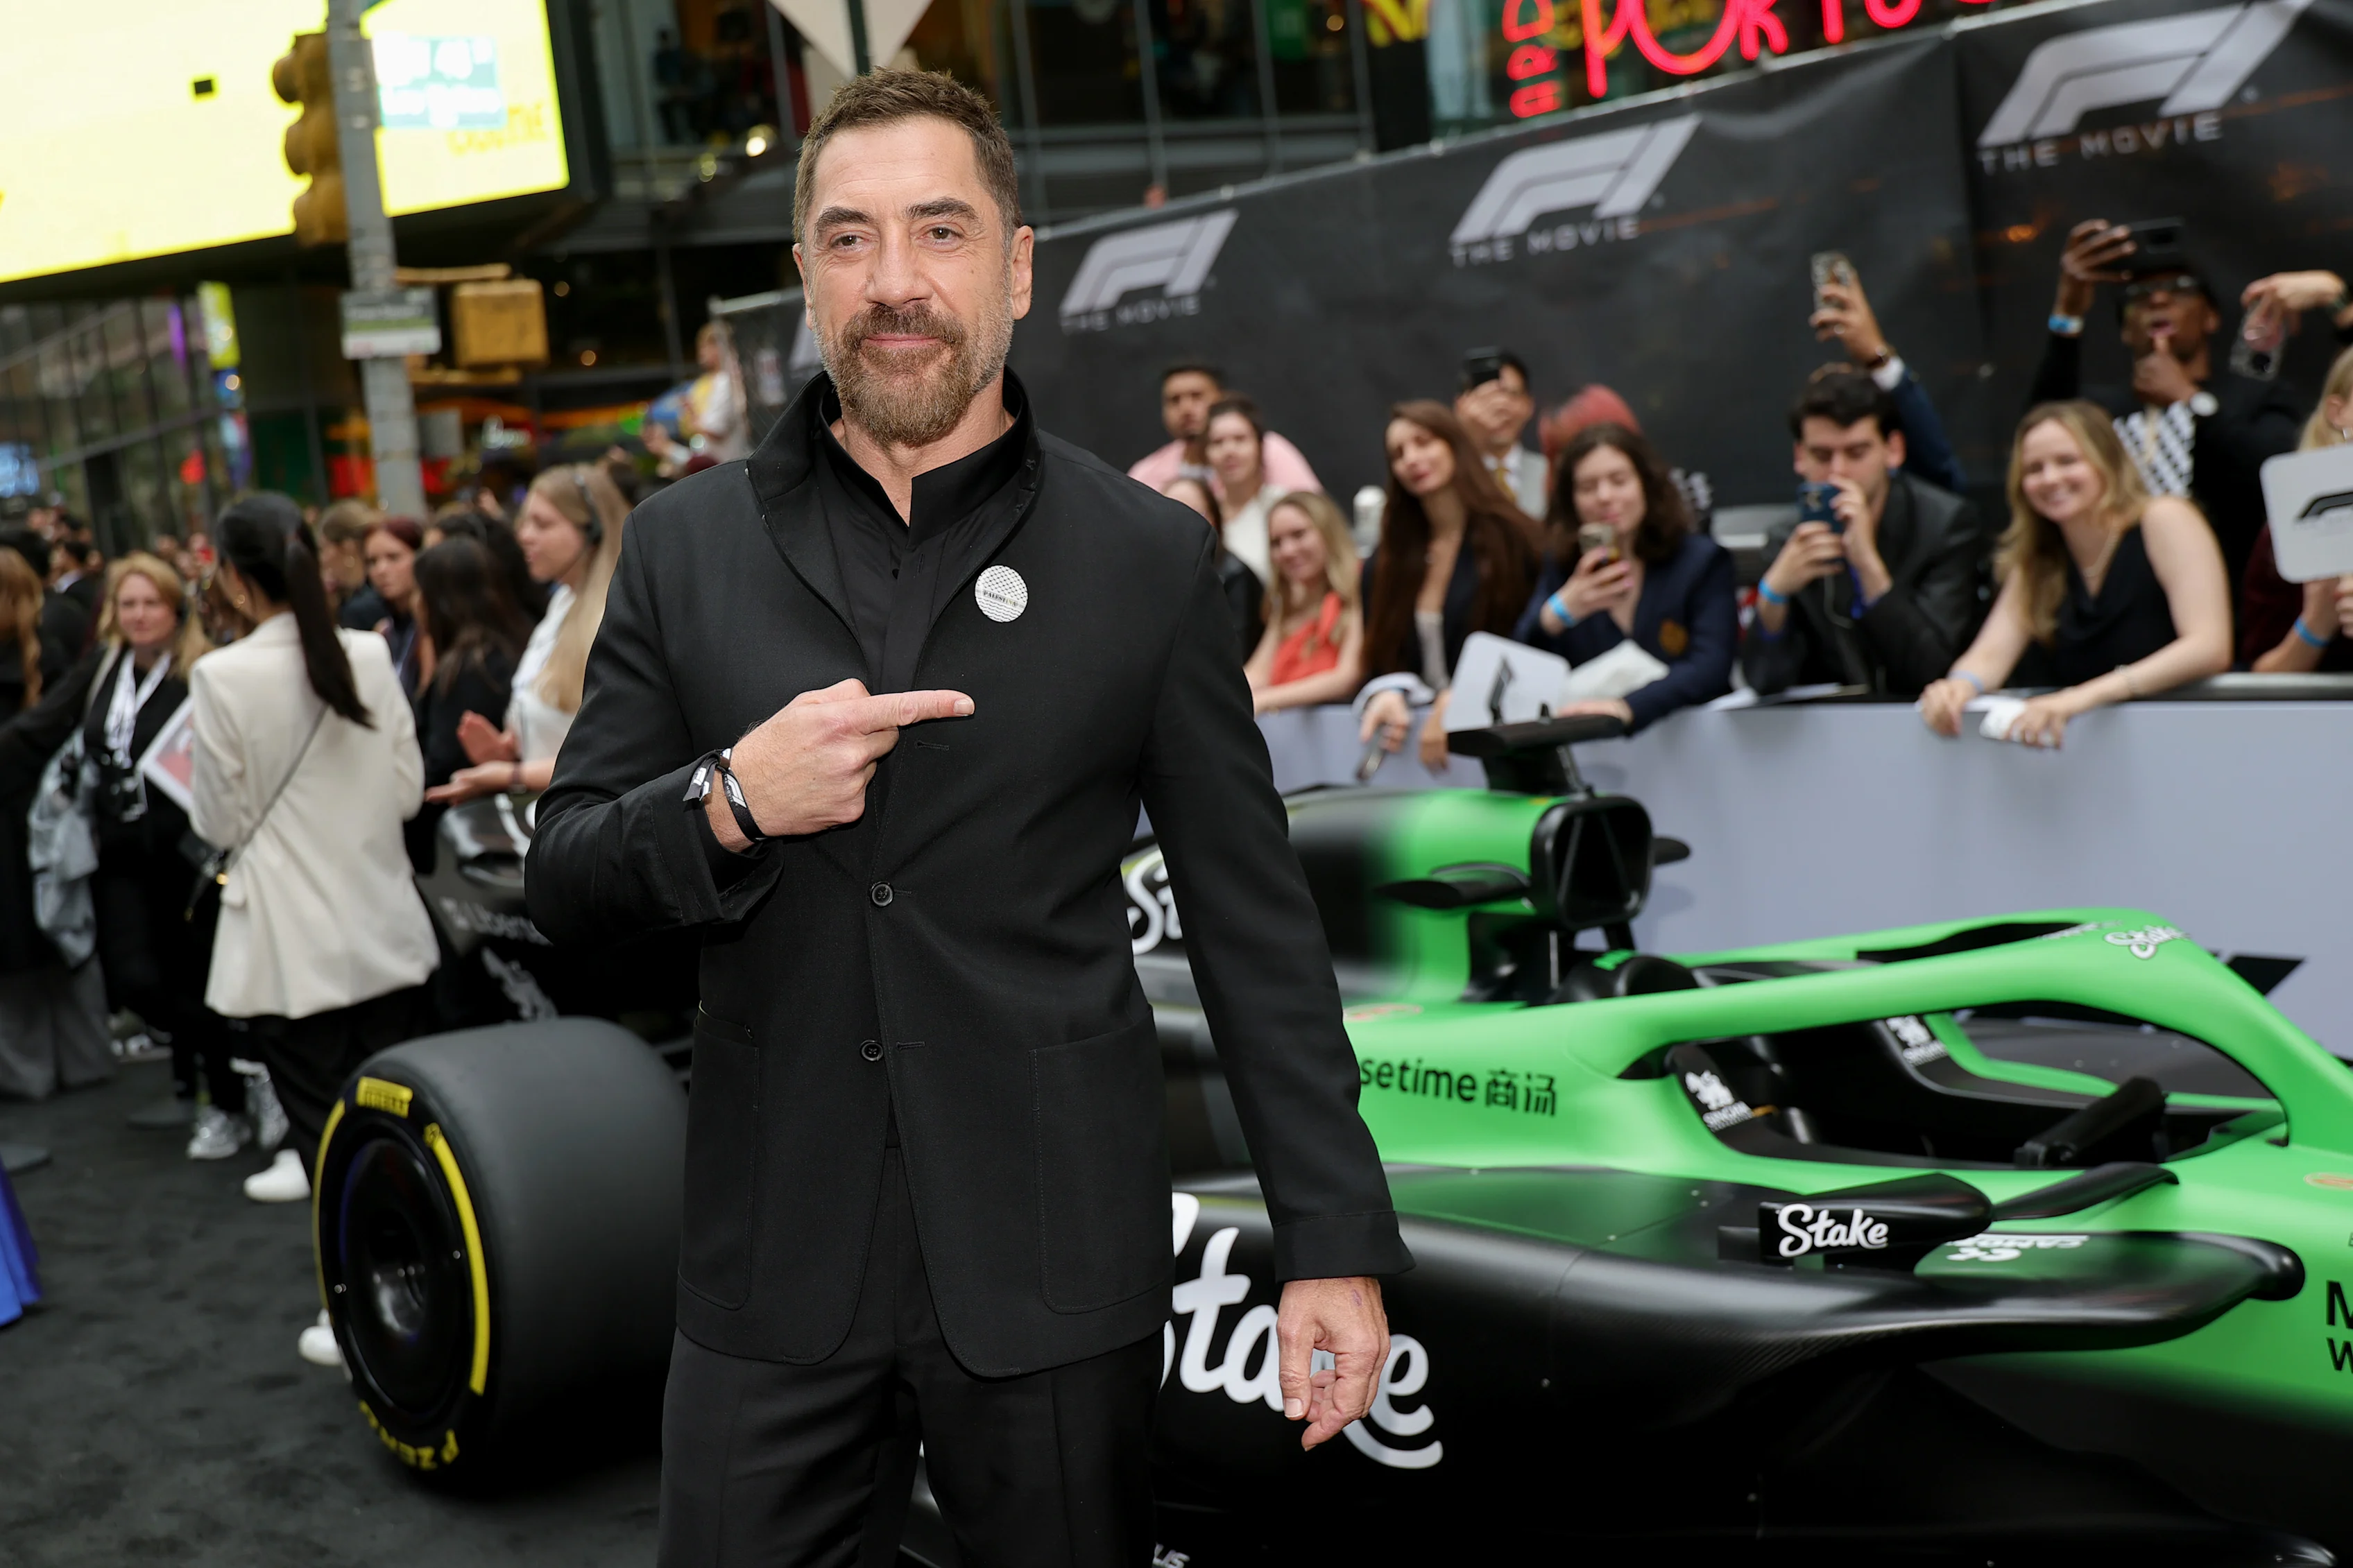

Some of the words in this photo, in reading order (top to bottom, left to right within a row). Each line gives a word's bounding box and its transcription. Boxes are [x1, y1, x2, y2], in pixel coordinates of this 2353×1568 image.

[1977, 140, 2059, 175] THE
[2080, 109, 2223, 160] MOVIE
[1448, 237, 1514, 268] THE
[1527, 214, 1639, 255] MOVIE
[1777, 1203, 1889, 1258] Stake
[1160, 1191, 1444, 1470] tae
